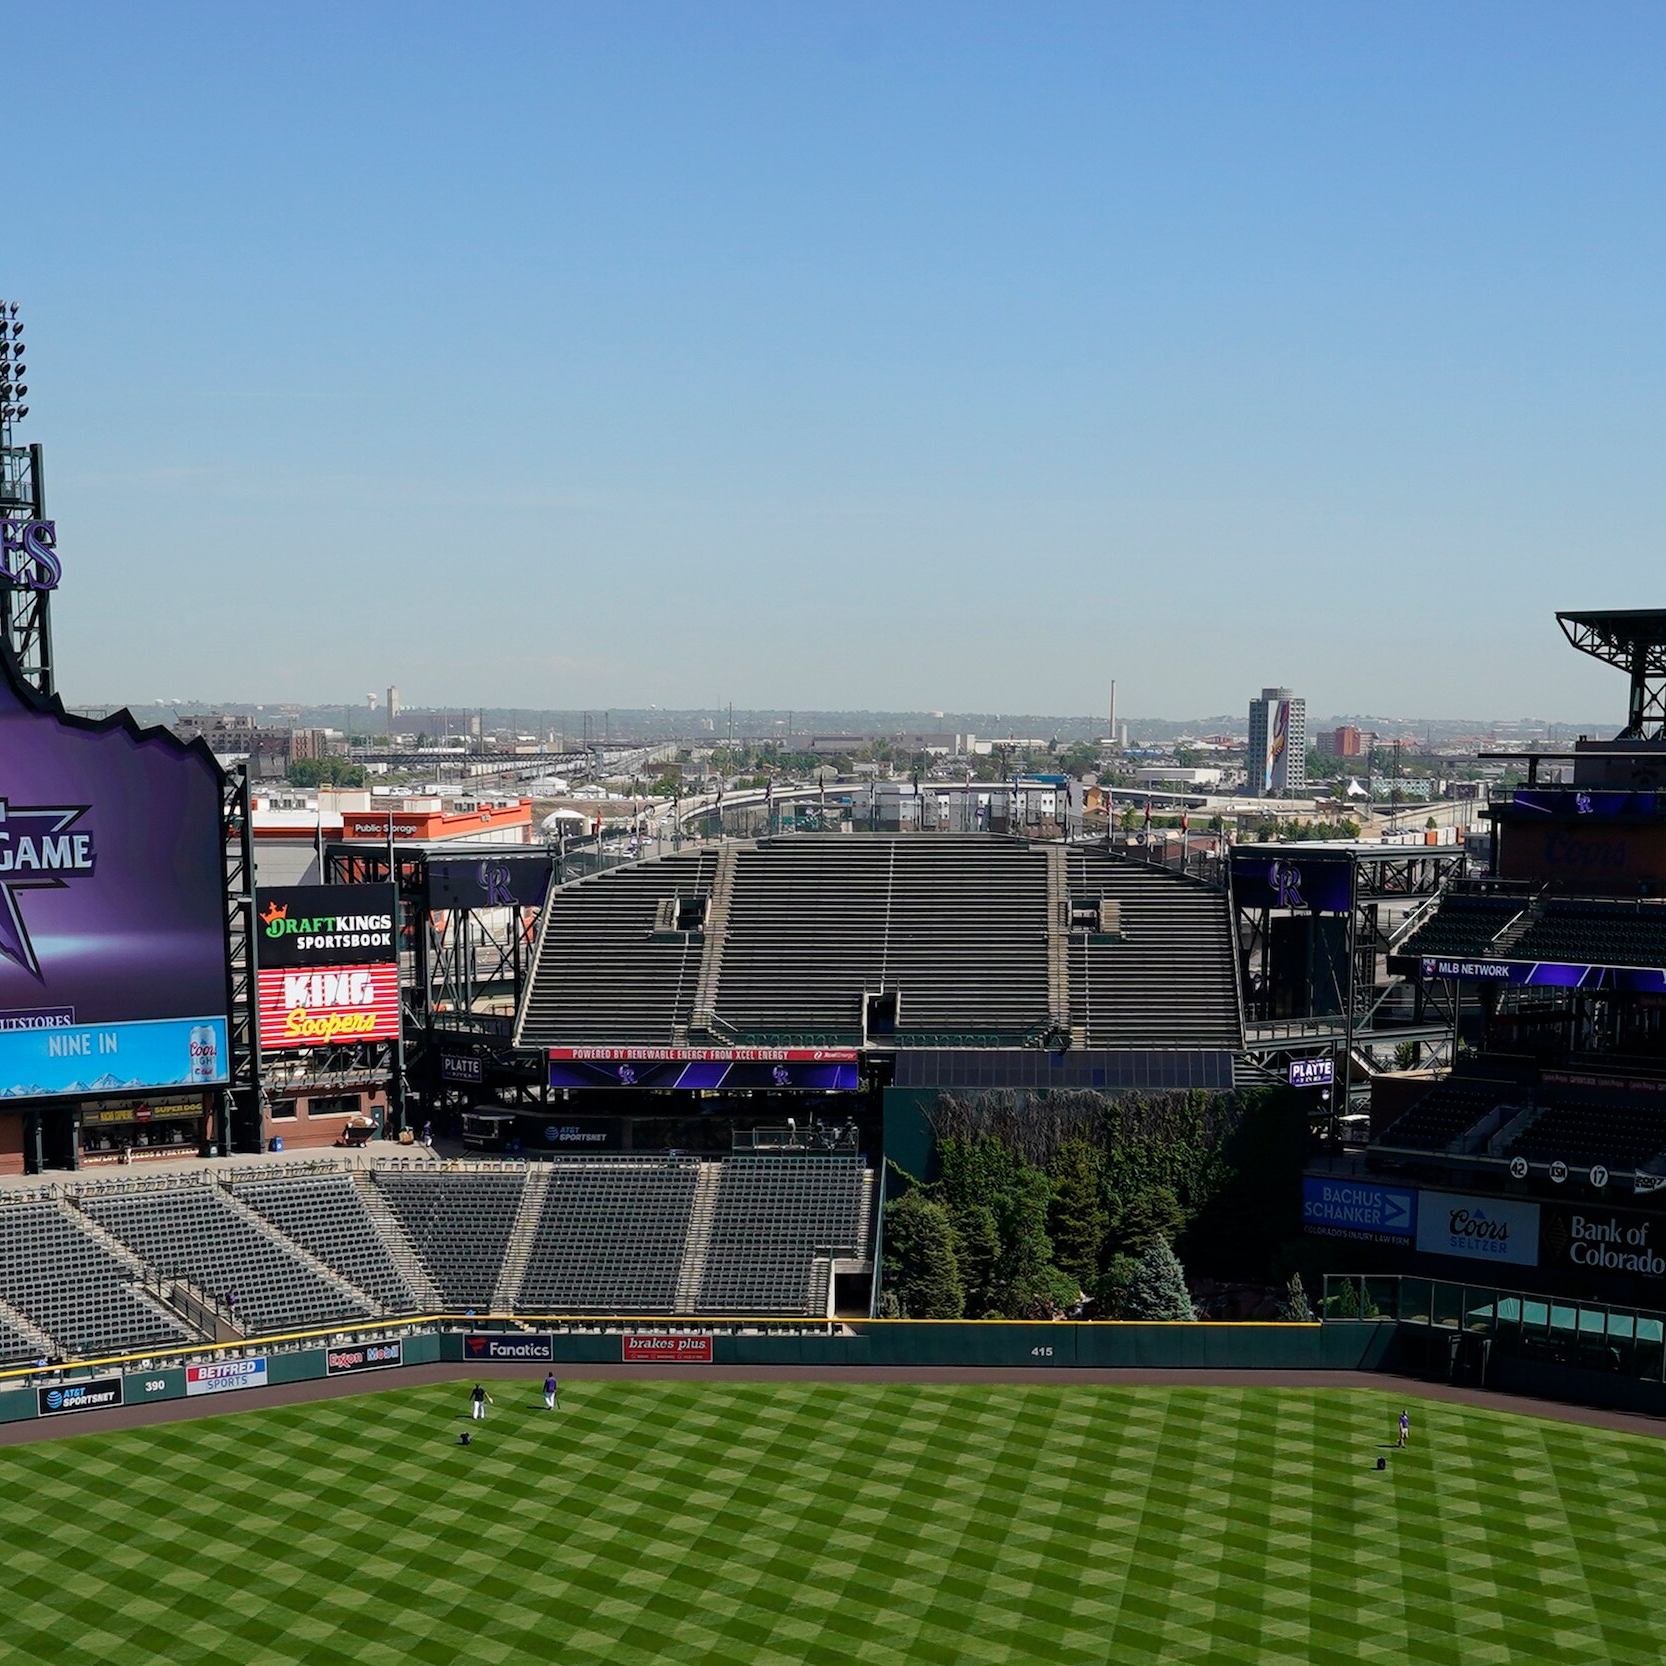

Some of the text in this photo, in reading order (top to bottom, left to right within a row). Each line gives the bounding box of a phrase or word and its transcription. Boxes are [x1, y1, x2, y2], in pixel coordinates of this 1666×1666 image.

[355, 823, 382, 834] Public
[265, 914, 392, 939] DRAFTKINGS
[297, 933, 391, 950] SPORTSBOOK
[1438, 962, 1510, 977] MLB NETWORK
[284, 972, 375, 1009] KING
[283, 1007, 378, 1044] Soopers
[48, 1032, 118, 1057] NINE IN
[572, 1049, 789, 1060] POWERED BY RENEWABLE ENERGY FROM XCEL ENERGY
[444, 1057, 480, 1073] PLATTE
[559, 1133, 608, 1141] SPORTSNET
[1511, 1161, 1526, 1175] 42
[1593, 1169, 1606, 1185] 17
[1636, 1176, 1664, 1187] 2007
[1322, 1186, 1382, 1207] BACHUS
[1304, 1201, 1382, 1225] SCHANKER
[1449, 1208, 1509, 1241] Coors
[1571, 1215, 1651, 1247] Bank of
[1303, 1225, 1411, 1247] COLORADO'S INJURY LAW FIRM
[1450, 1236, 1508, 1254] SELTZER
[1569, 1241, 1666, 1276] Colorado
[489, 1341, 550, 1357] Fanatics
[629, 1337, 707, 1351] brakes plus
[1031, 1347, 1053, 1357] 415
[329, 1345, 400, 1369] Exxon Mobil
[198, 1360, 257, 1380] BETFRED
[145, 1380, 166, 1393] 390
[207, 1375, 248, 1390] SPORTS
[63, 1387, 86, 1399] AT&T
[63, 1391, 115, 1408] SPORTSNET
